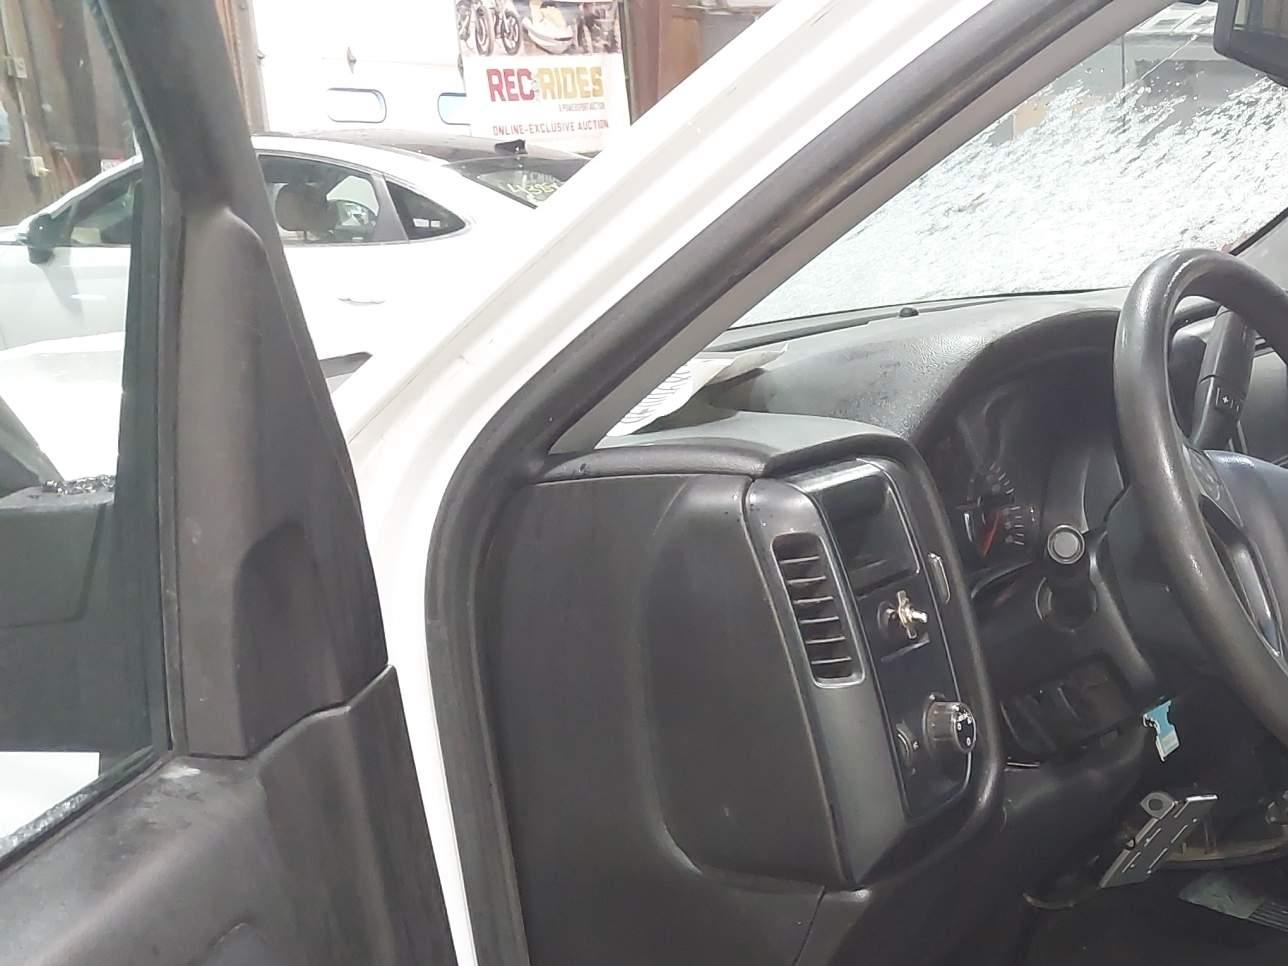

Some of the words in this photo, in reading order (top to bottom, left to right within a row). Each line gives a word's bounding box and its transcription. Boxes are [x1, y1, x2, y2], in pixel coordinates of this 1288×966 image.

[486, 68, 535, 102] REC
[537, 66, 604, 100] RIDES
[493, 121, 575, 136] ONLINE-EXCLUSIVE
[578, 119, 609, 131] AUCTION
